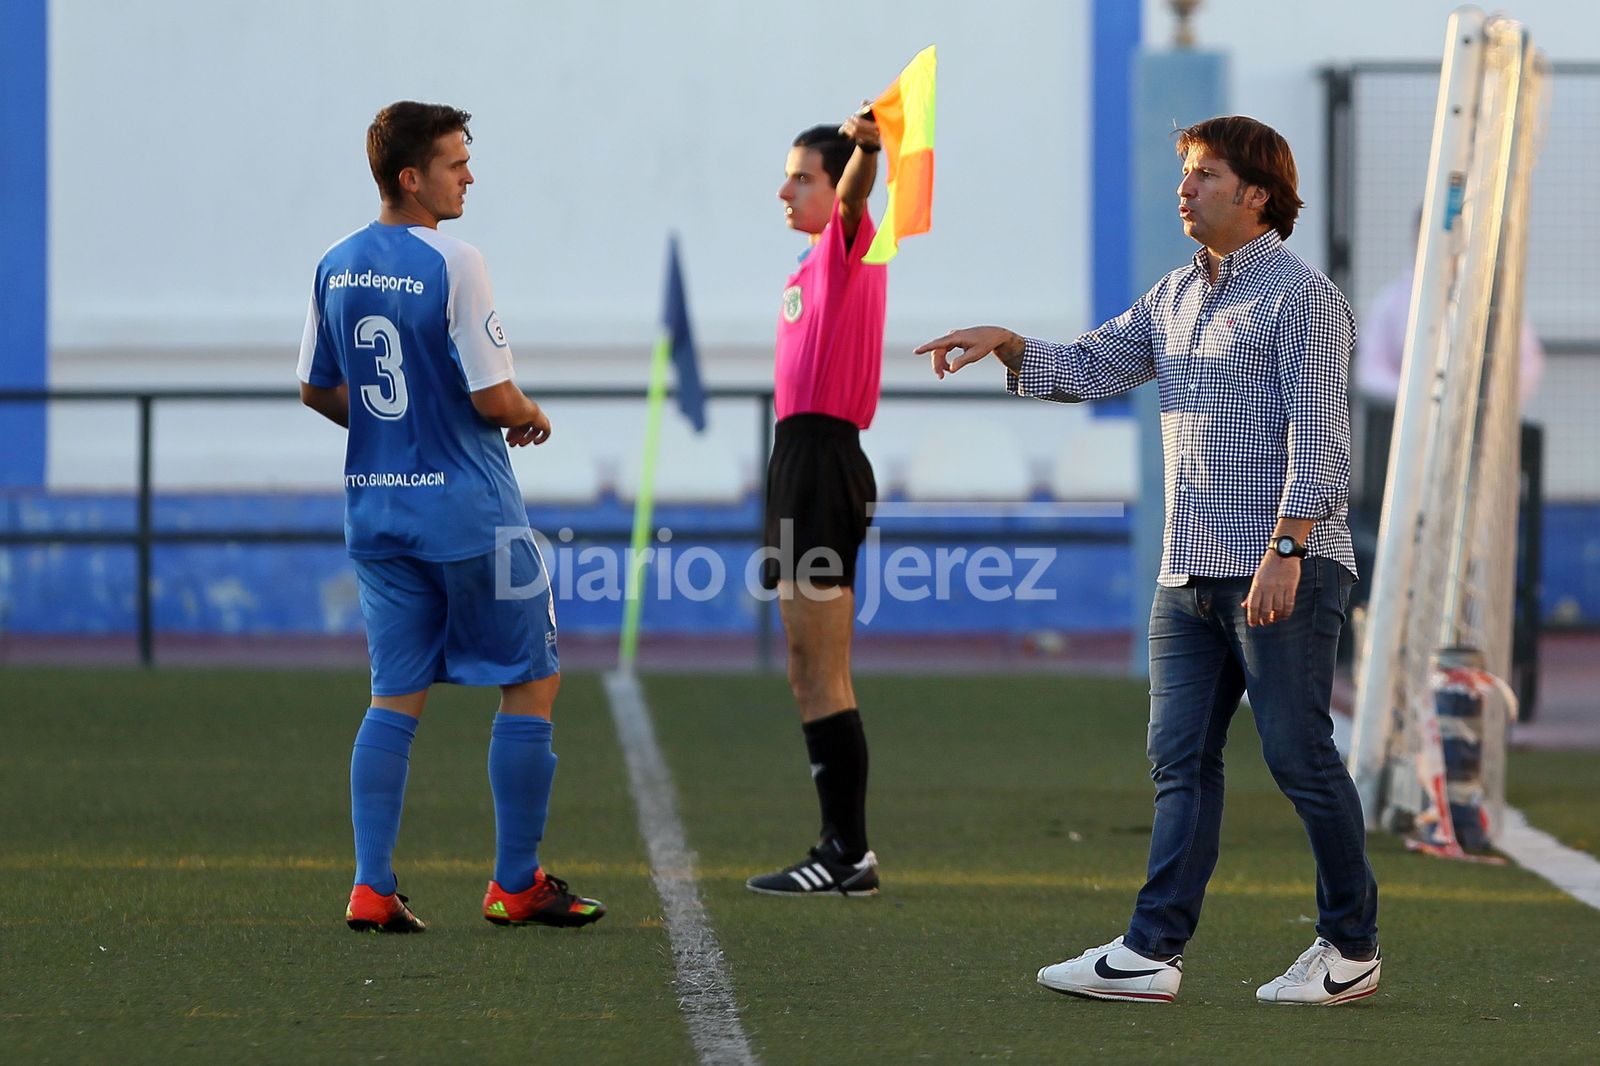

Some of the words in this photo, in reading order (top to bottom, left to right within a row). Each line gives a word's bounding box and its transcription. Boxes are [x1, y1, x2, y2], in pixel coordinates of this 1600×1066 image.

[328, 268, 424, 294] saludeporte
[496, 326, 504, 340] 3
[354, 315, 409, 420] 3
